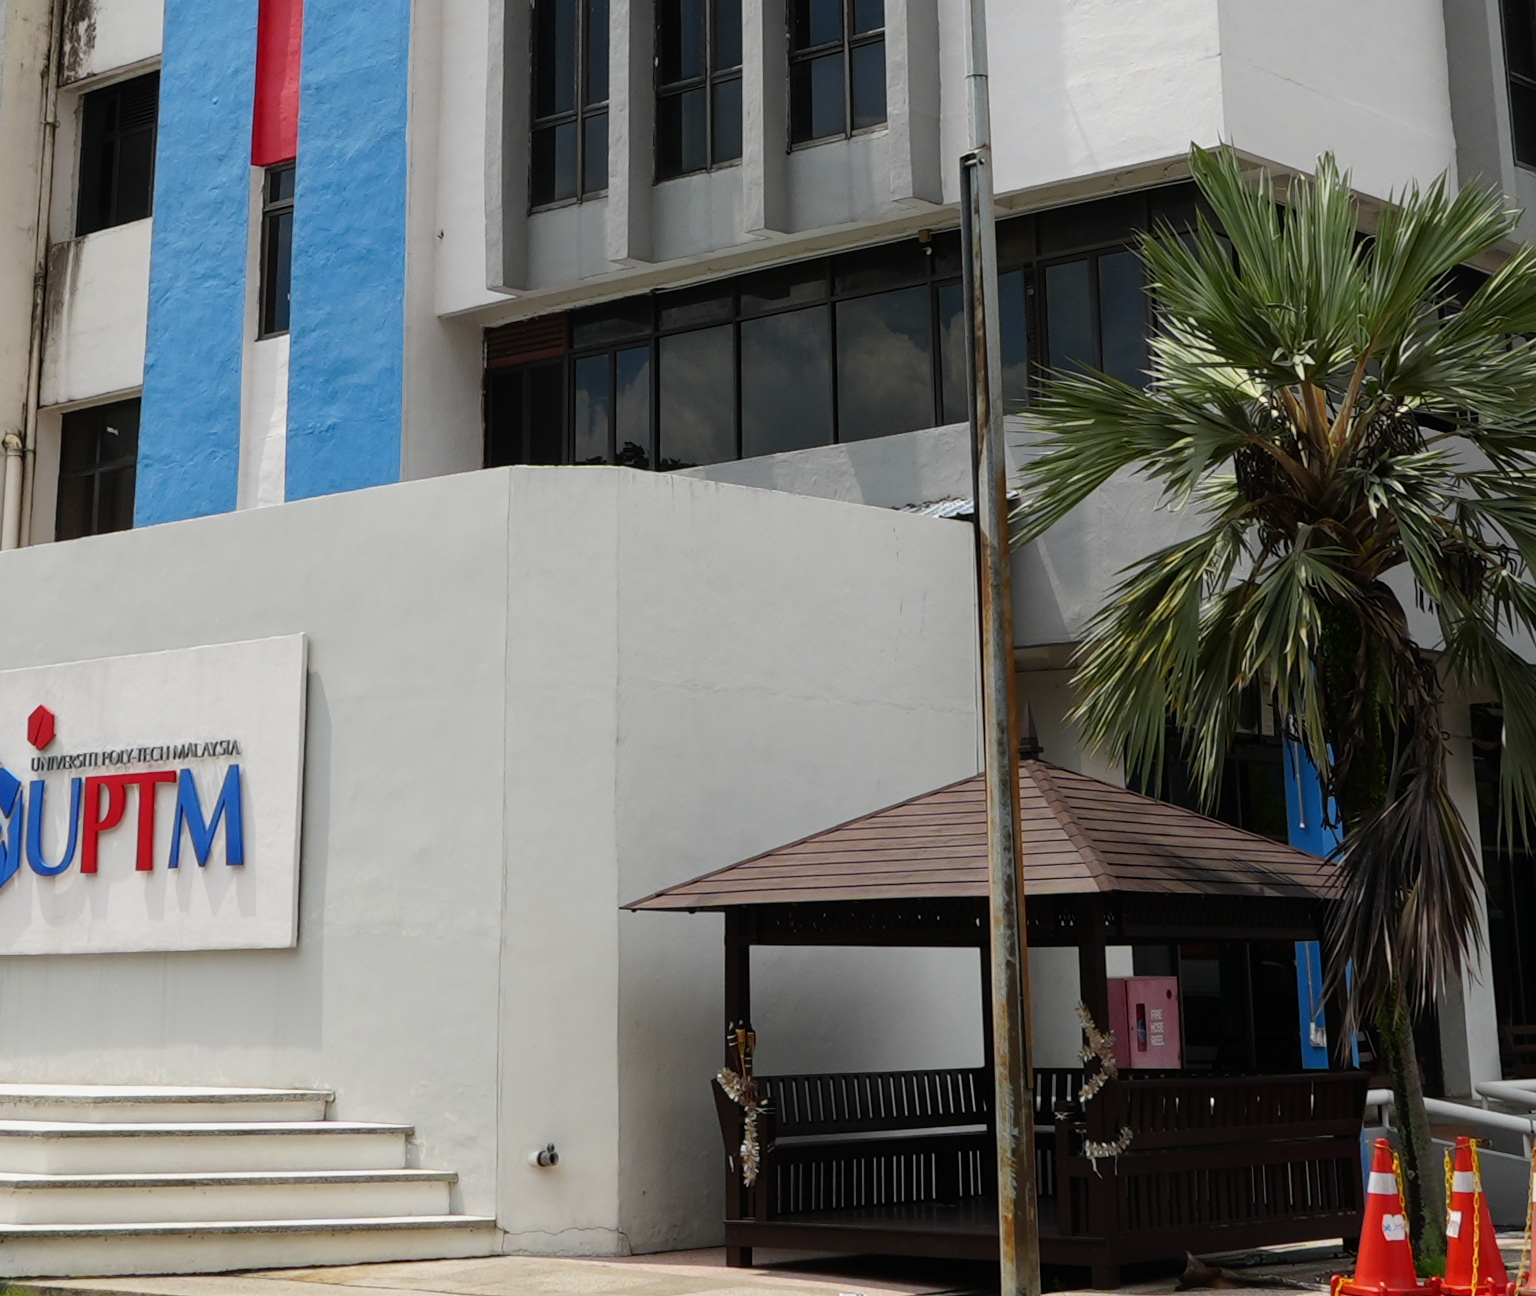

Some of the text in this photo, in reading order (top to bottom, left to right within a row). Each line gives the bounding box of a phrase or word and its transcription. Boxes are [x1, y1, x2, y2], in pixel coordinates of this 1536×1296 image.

[31, 739, 242, 772] UNIVERSITI POLY-TECH MALAYSIA
[26, 764, 244, 877] UPTM
